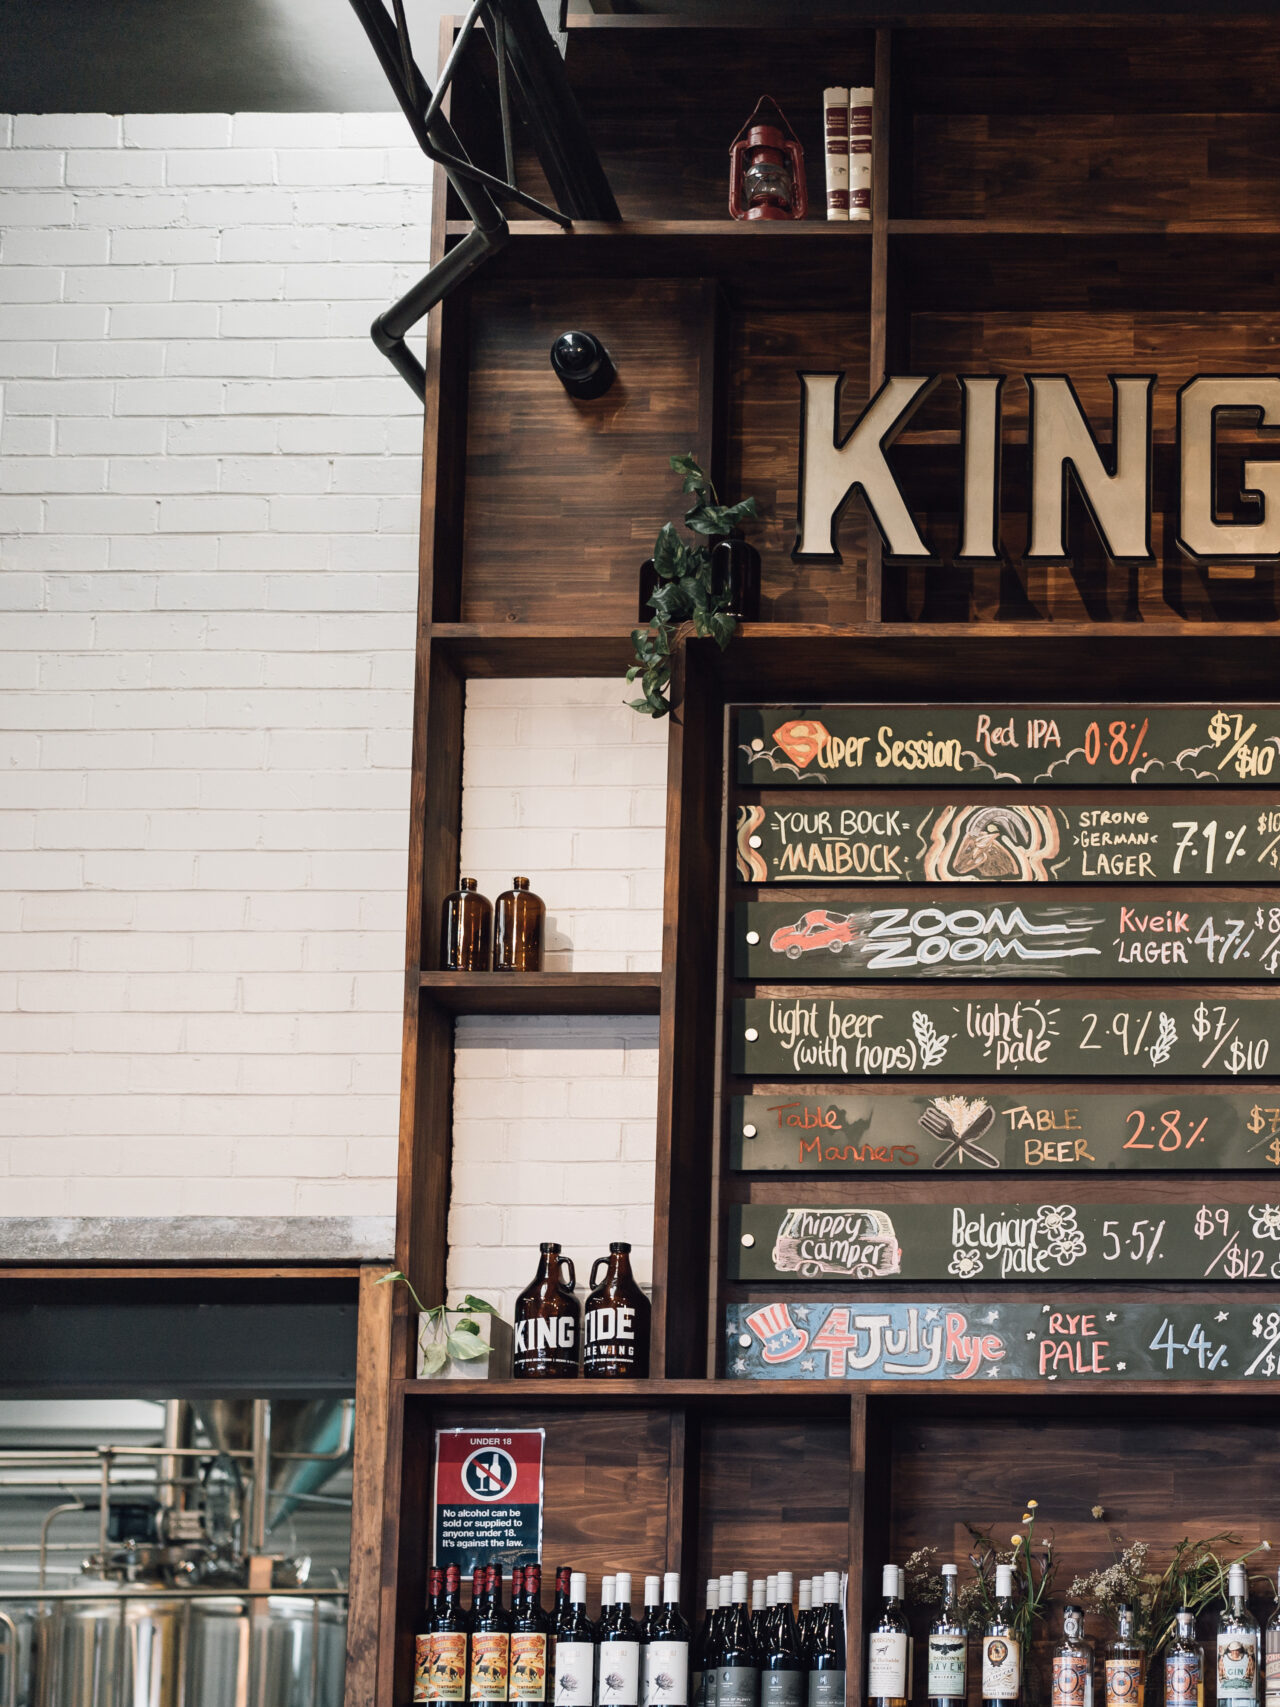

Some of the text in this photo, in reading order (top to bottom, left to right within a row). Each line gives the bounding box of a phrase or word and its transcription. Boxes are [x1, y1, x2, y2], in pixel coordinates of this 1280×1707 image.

[875, 725, 964, 771] Session
[976, 714, 1063, 757] Red IPA
[775, 810, 902, 837] YOUR BOCK
[1078, 811, 1150, 827] STRONG
[781, 841, 902, 874] MAIBOCK
[1082, 851, 1157, 877] LAGER
[869, 907, 1066, 937] ZOOM
[1119, 906, 1190, 934] Kveik
[867, 938, 1070, 969] ZOOM
[769, 1001, 884, 1048] light beer
[966, 1003, 1025, 1044] light
[794, 1034, 917, 1074] (with hops)
[997, 1037, 1051, 1071] pale
[768, 1103, 843, 1131] Table
[1001, 1107, 1083, 1131] TABLE
[799, 1138, 920, 1166] Manners
[1024, 1138, 1096, 1165] BEER
[800, 1212, 863, 1243] hippy
[952, 1207, 1039, 1260] Belgian
[800, 1238, 886, 1268] camper
[1001, 1242, 1051, 1279] pale
[515, 1316, 575, 1354] KING
[584, 1307, 635, 1345] TIDE
[1048, 1312, 1099, 1336] RYE
[810, 1308, 1007, 1379] 4 July Rye
[1038, 1340, 1111, 1375] PALE
[443, 1509, 456, 1517] No
[458, 1509, 489, 1517] alcohol
[509, 1509, 521, 1517] be
[443, 1519, 461, 1527] sold
[474, 1519, 511, 1529] supplied
[442, 1529, 516, 1539] anyone under 18.
[442, 1539, 523, 1549] It's against the law.
[1227, 1668, 1244, 1676] GIN
